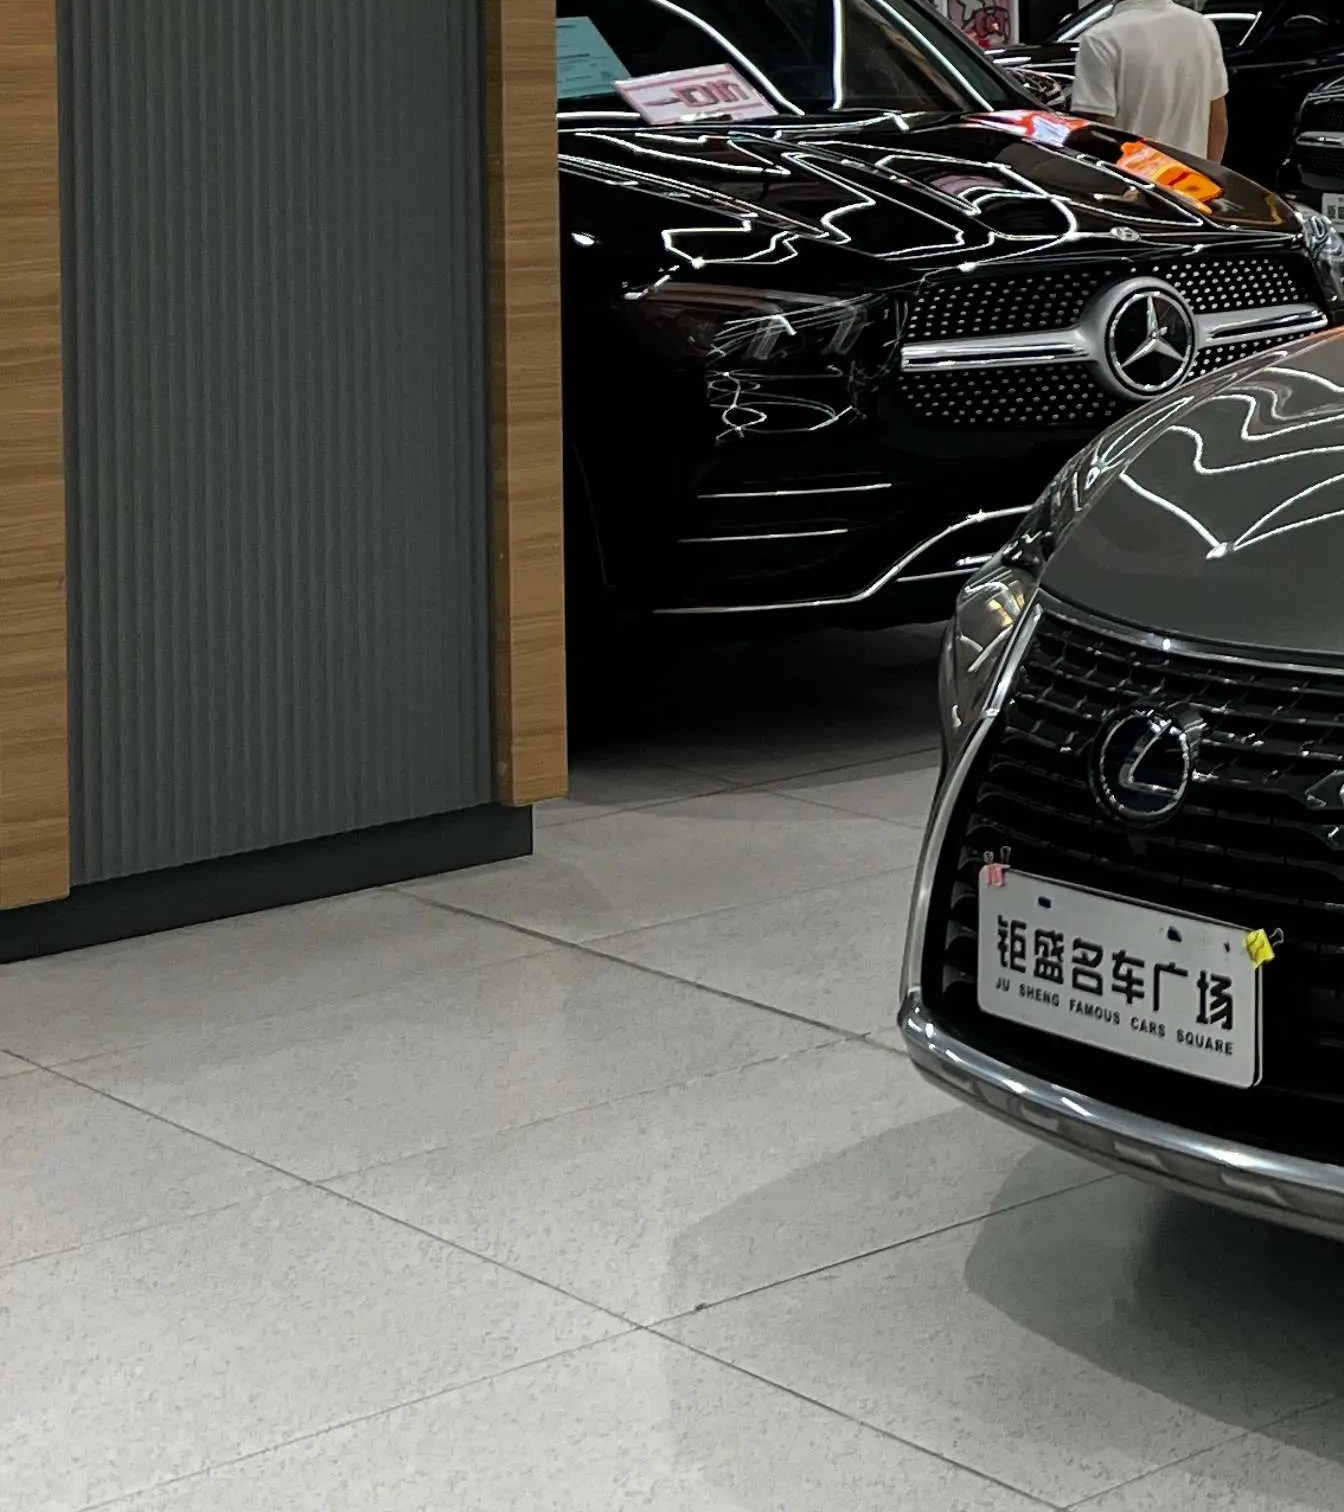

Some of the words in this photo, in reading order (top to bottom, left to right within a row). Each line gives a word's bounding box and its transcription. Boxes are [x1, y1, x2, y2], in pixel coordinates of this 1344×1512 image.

[996, 976, 1010, 992] JU
[1019, 983, 1060, 1007] SHENG
[1069, 998, 1121, 1025] FAMOUS
[1130, 1016, 1166, 1038] CARS
[1176, 1028, 1234, 1056] SQUARE
[997, 914, 1233, 1031] 钜盛名车广场
